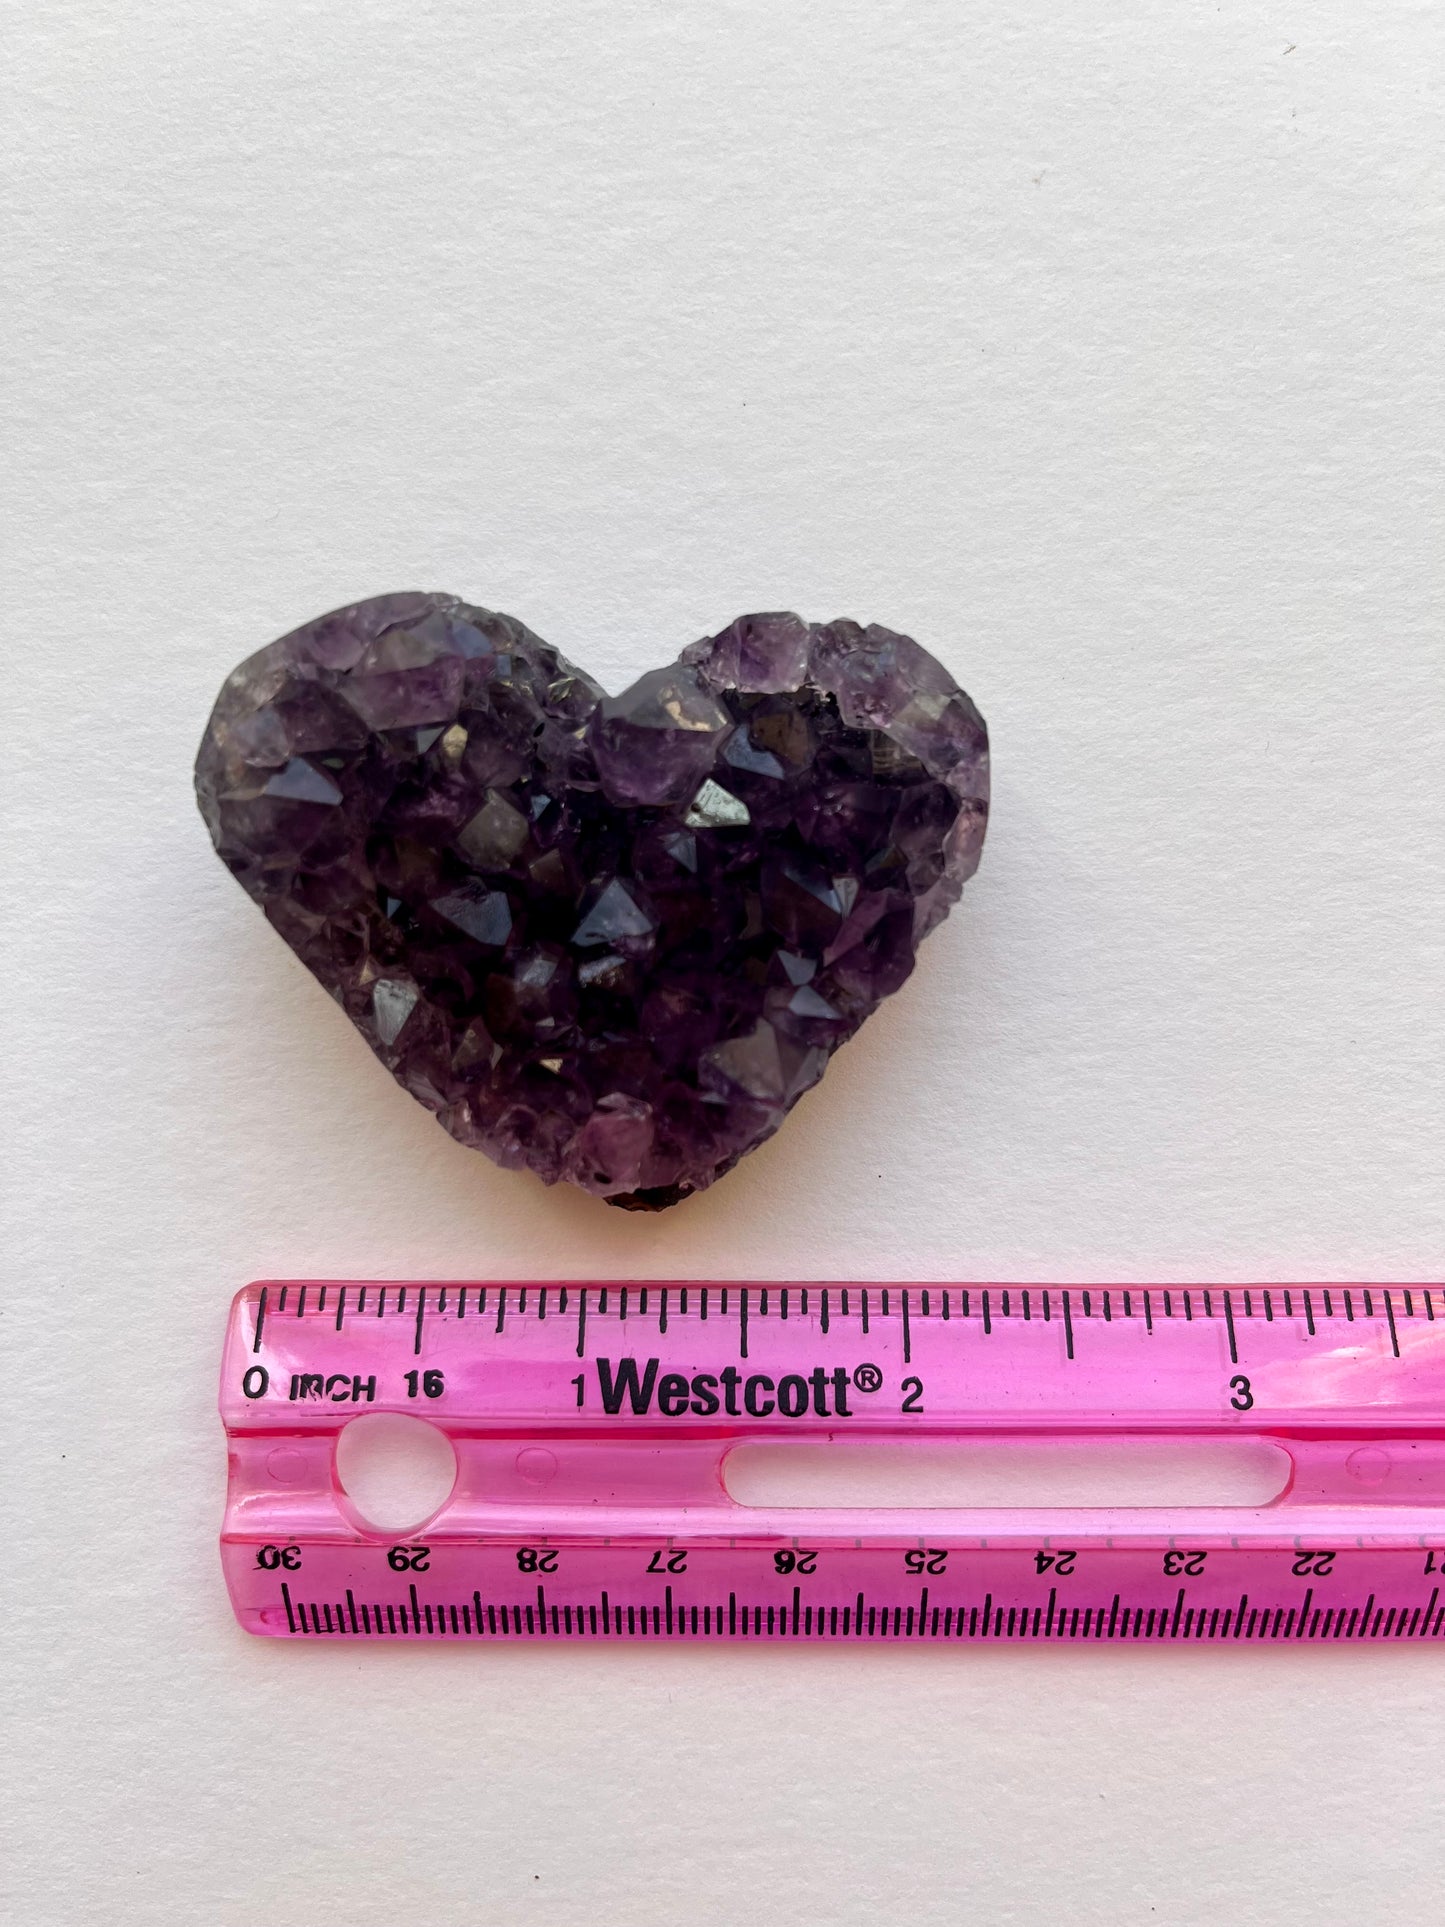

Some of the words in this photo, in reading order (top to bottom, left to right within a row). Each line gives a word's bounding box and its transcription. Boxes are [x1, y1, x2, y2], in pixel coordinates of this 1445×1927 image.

[242, 1365, 269, 1399] 0
[289, 1373, 377, 1402] INCH
[403, 1369, 445, 1399] 16
[571, 1374, 585, 1406] 1
[901, 1377, 924, 1413] 2
[1230, 1374, 1254, 1411] 3
[257, 1546, 302, 1571] 30
[387, 1546, 431, 1573] 29
[517, 1548, 560, 1574] 28
[646, 1550, 688, 1575] 27
[774, 1549, 818, 1575] 26
[905, 1550, 948, 1576] 25
[1034, 1551, 1077, 1576] 24
[1164, 1551, 1207, 1577] 23
[1292, 1551, 1336, 1577] 22
